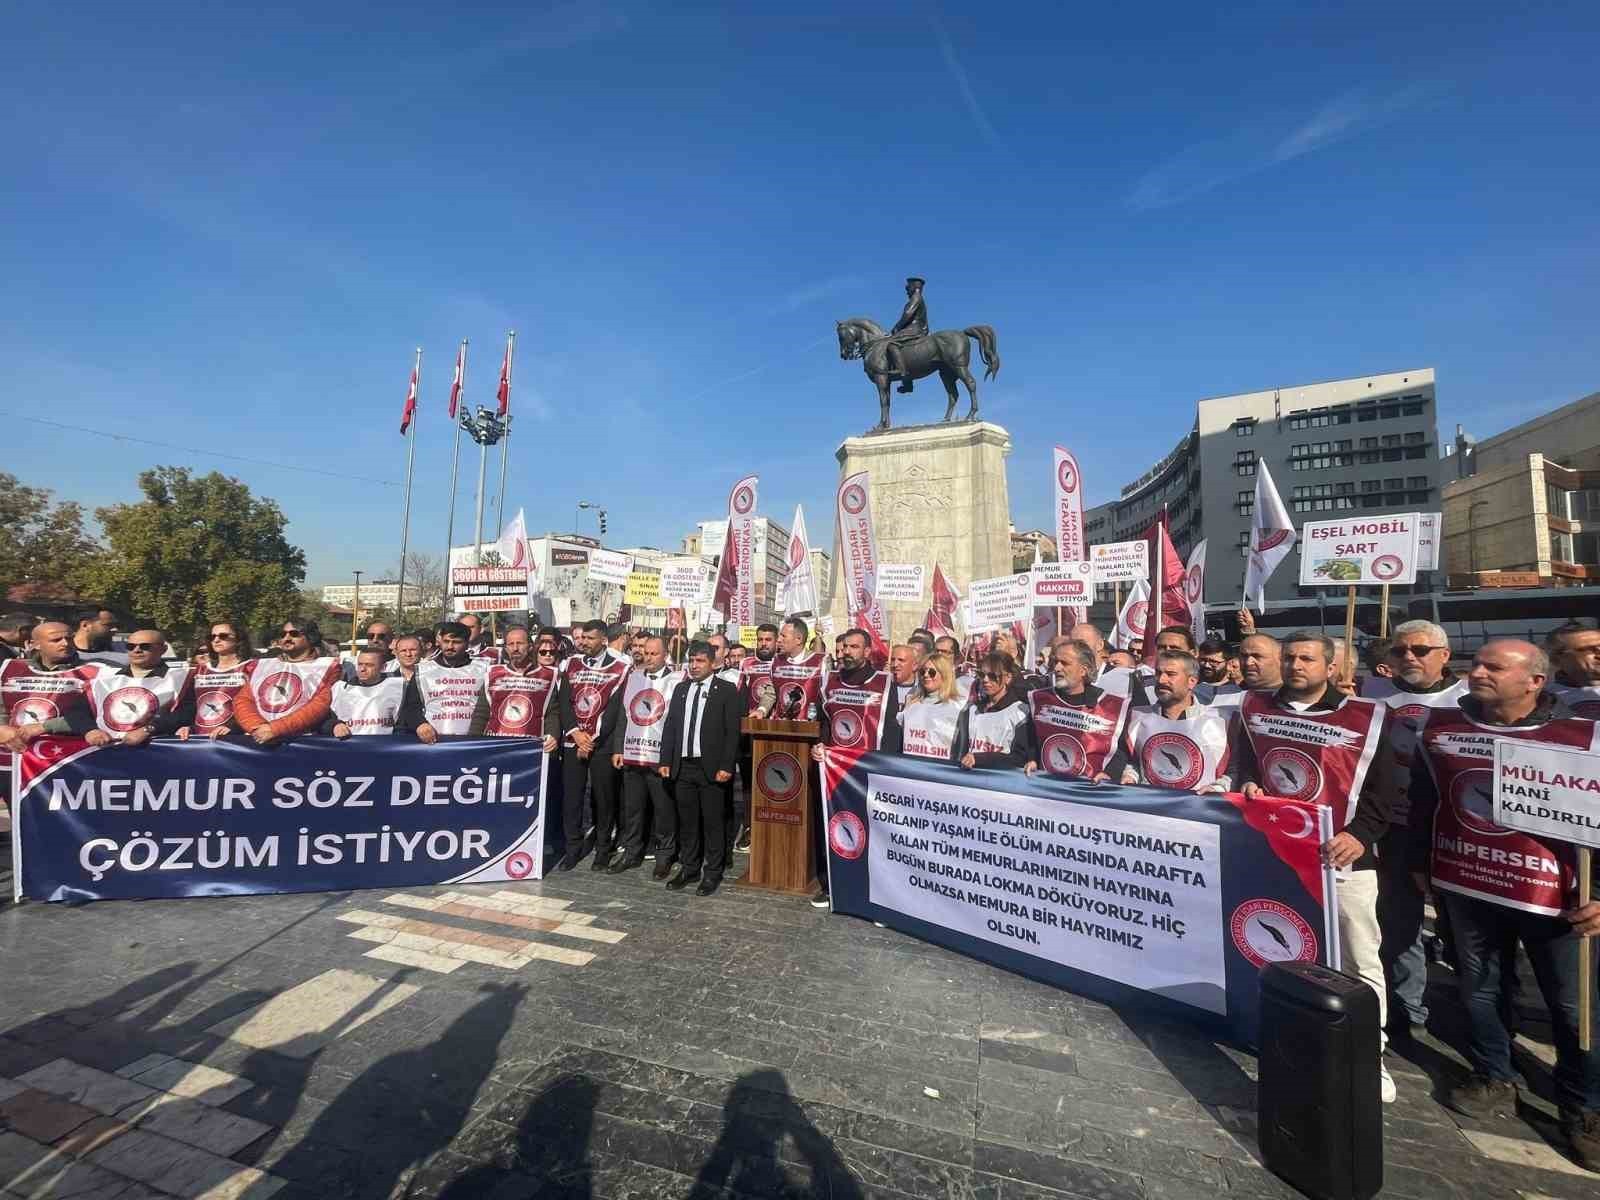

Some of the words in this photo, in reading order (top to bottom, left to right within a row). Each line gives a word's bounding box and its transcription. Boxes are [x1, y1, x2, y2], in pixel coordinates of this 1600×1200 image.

[1311, 527, 1347, 540] EŞEL
[1352, 519, 1409, 535] MOBİL
[1335, 542, 1378, 557] ŞART
[1040, 584, 1081, 593] HAKKINI
[909, 728, 927, 738] YHS
[1260, 717, 1319, 732] HAKLARIMIZ
[1319, 727, 1342, 737] İÇİN
[1268, 727, 1328, 744] BURADAYIZ!
[1447, 735, 1495, 745] HAKLAR
[1458, 747, 1494, 756] BURA
[48, 777, 256, 811] MEMUR
[272, 770, 374, 808] SÖZ
[389, 767, 535, 810] DEĞİL,
[1502, 783, 1551, 801] HANİ
[874, 791, 915, 809] ASGARİ
[916, 798, 959, 816] YAŞAM
[961, 806, 1055, 833] KOŞULLARINI
[1058, 822, 1204, 861] OLUŞTURMAKTA
[79, 830, 280, 881] ÇÖZÜM
[298, 825, 491, 866] İSTİYOR
[872, 809, 929, 829] ZORLANIP
[931, 820, 975, 840] YAŞAM
[977, 827, 998, 845] İLE
[1000, 832, 1043, 854] ÖLÜM
[1046, 844, 1129, 872] ARASINDA
[1132, 860, 1206, 888] ARAFTA
[1437, 833, 1560, 875] ÜNİPERSEN
[890, 832, 929, 852] KALAN
[931, 840, 959, 859] TÜM
[961, 851, 1090, 888] MEMURLARIMIZIN
[1093, 876, 1174, 907] HAYRINA
[1506, 871, 1560, 889] Personel
[887, 849, 926, 872] BUGÜN
[928, 861, 981, 885] BURADA
[984, 874, 1035, 898] LOKMA
[1038, 887, 1148, 926] DÖKÜYORUZ.
[1152, 914, 1186, 938] HİÇ
[908, 875, 965, 902] OLMAZSA
[967, 891, 1029, 919] MEMURA
[1032, 907, 1058, 928] BİR
[1061, 916, 1144, 950] HAYRIMIZ
[987, 918, 1041, 946] OLSUN.
